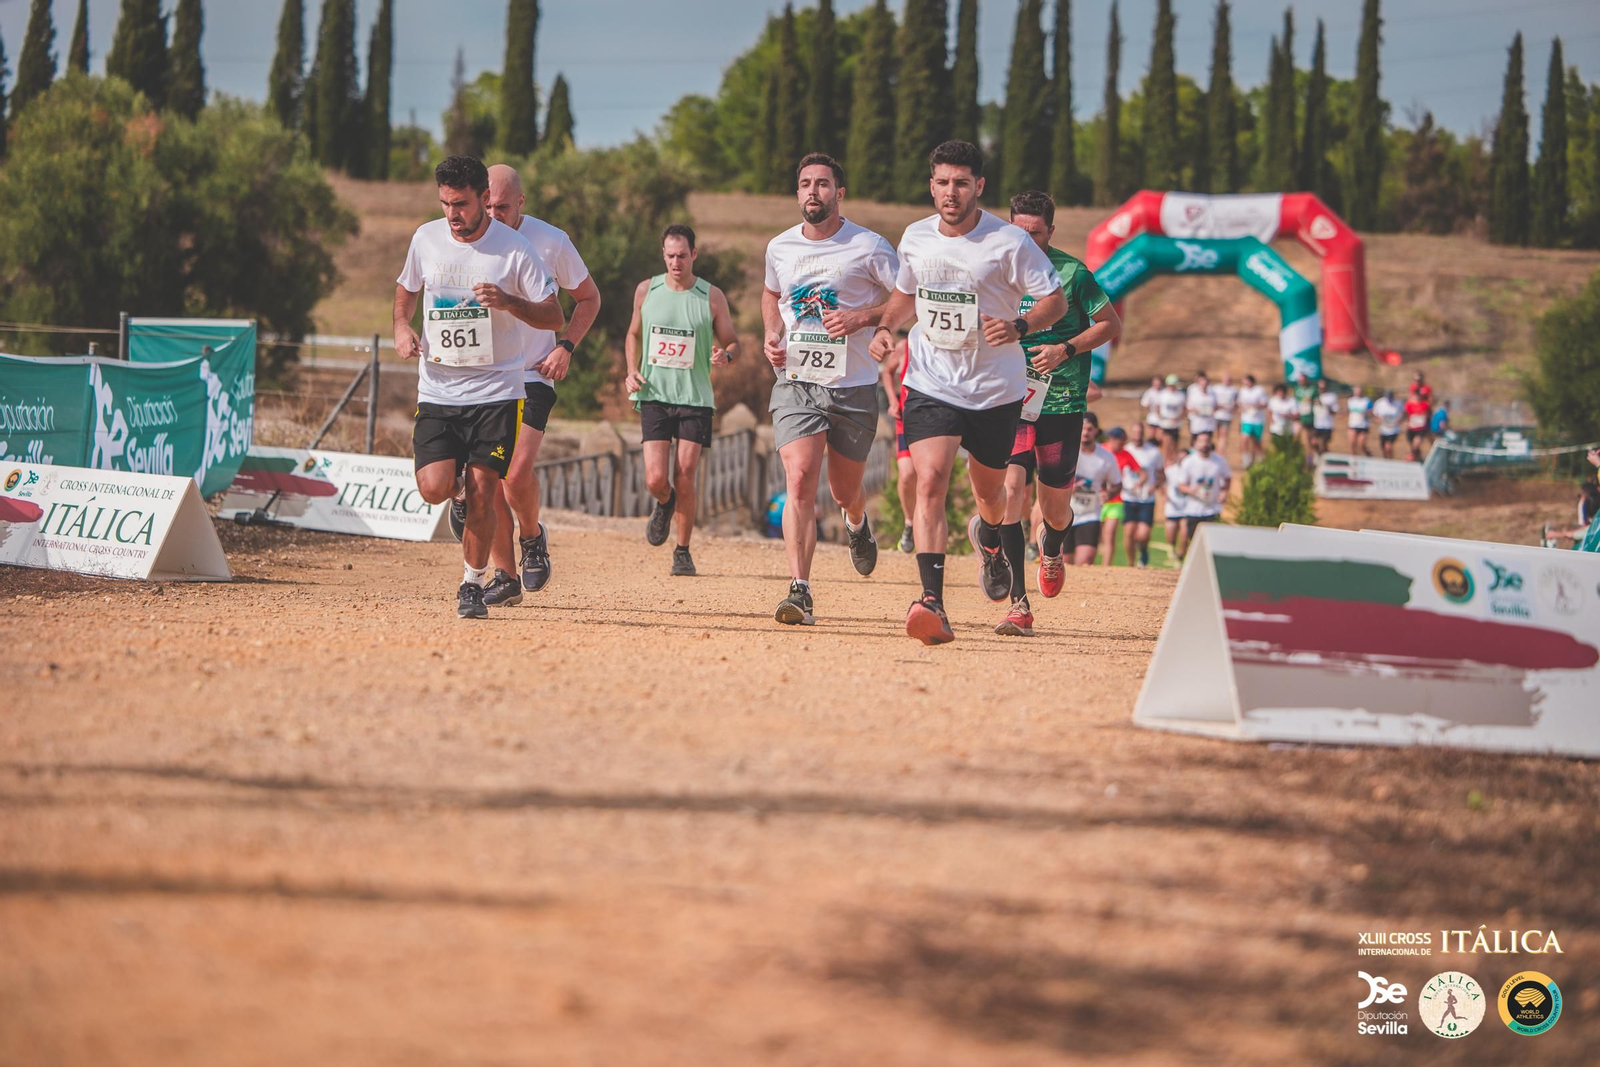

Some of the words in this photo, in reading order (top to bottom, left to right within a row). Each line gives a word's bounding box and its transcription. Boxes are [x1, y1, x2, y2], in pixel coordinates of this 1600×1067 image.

[928, 309, 965, 331] 751
[441, 328, 480, 348] 861
[658, 342, 687, 357] 257
[799, 350, 836, 369] 782
[60, 479, 87, 491] CROSS
[88, 482, 157, 499] INTERNACIONAL
[160, 489, 176, 500] DE
[39, 496, 158, 546] ITÁLICA
[33, 538, 87, 553] INTERNATIONAL
[88, 544, 112, 555] CROSS
[112, 547, 148, 559] COUNTRY
